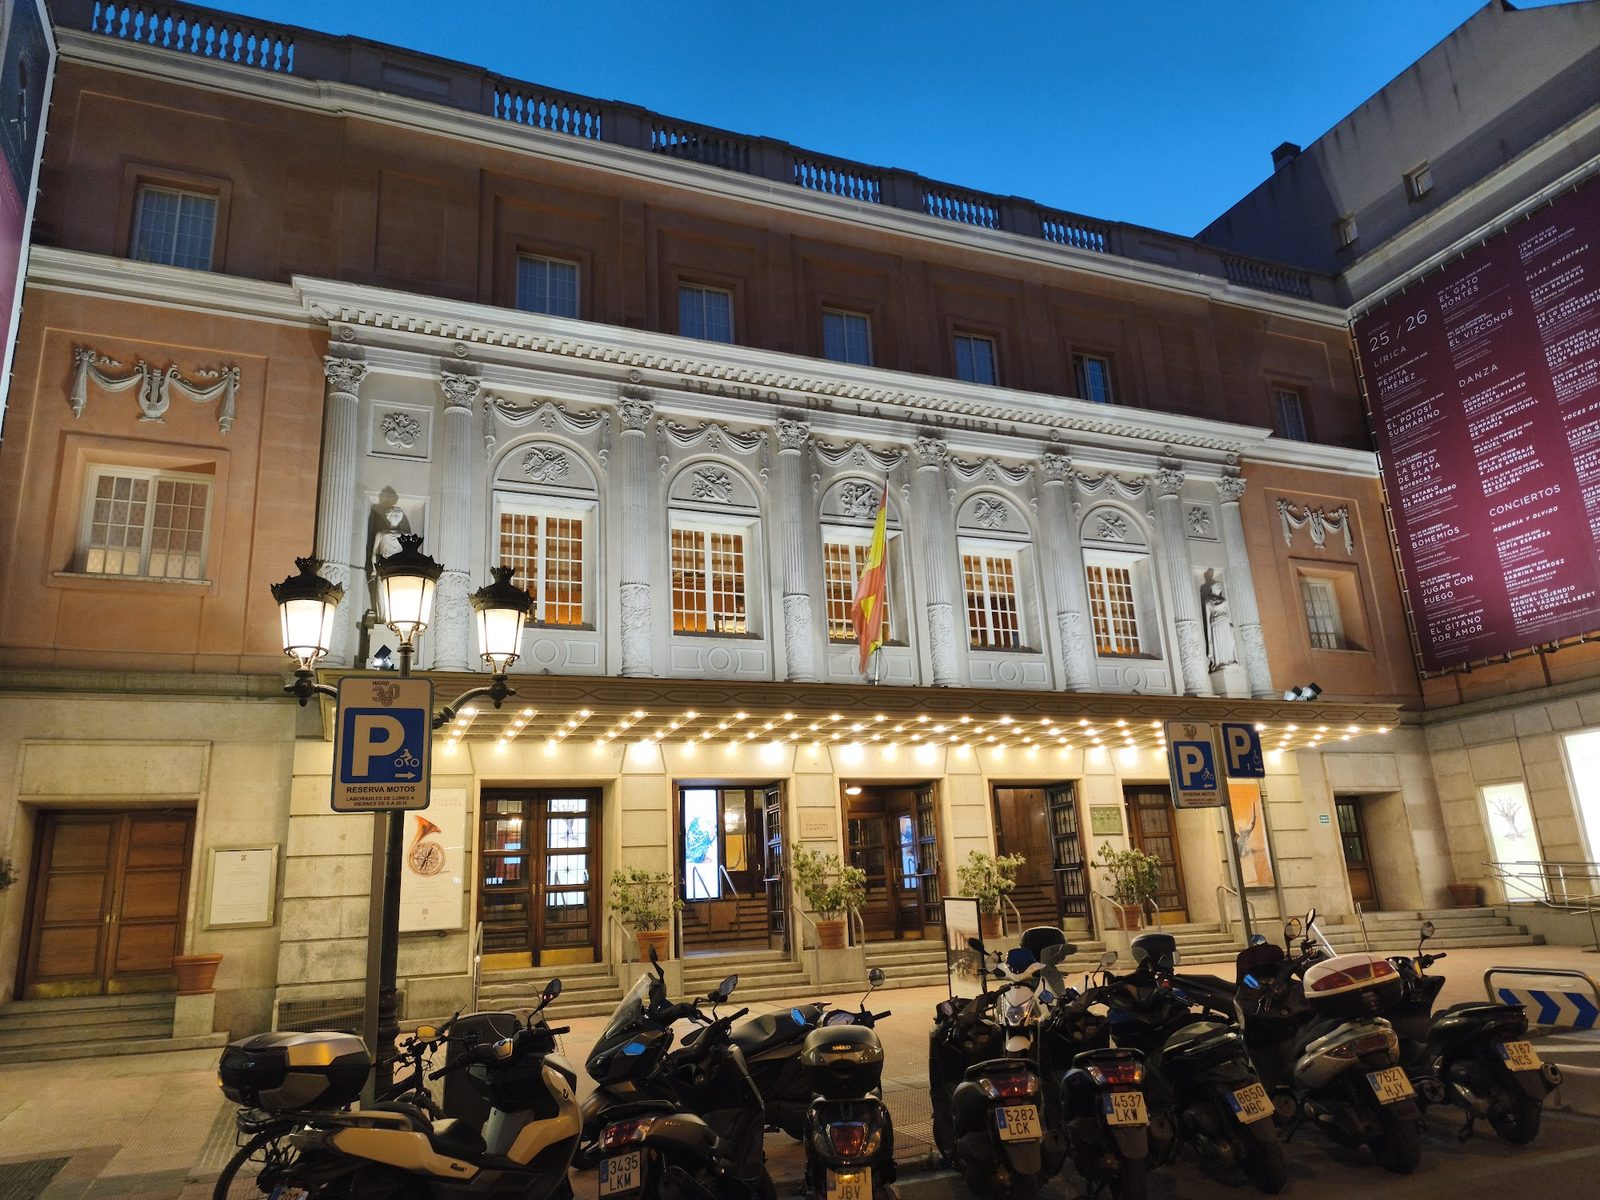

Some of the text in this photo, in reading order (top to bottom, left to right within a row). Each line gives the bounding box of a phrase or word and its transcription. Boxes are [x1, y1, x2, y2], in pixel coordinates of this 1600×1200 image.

[1552, 244, 1588, 267] NOSOTRAS
[1439, 293, 1450, 303] EL
[1453, 276, 1478, 294] GATO
[1531, 287, 1549, 299] SARA
[1551, 268, 1584, 288] BAÑERAS
[1441, 285, 1478, 310] MONTES
[1537, 316, 1546, 324] DE
[1548, 310, 1558, 318] LO
[1545, 317, 1555, 325] LO
[1369, 330, 1389, 352] 25
[1406, 309, 1427, 332] 26
[1449, 338, 1460, 347] EL
[1464, 309, 1513, 338] VIZCONDE
[1546, 346, 1562, 357] SIRA
[1547, 348, 1571, 362] OLIVIA
[1548, 355, 1567, 367] OLGA
[1378, 369, 1407, 387] PEPITA
[1380, 372, 1415, 395] JIMÉNEZ
[1459, 364, 1498, 388] DANZA
[1553, 371, 1578, 386] ELVIRA
[1465, 397, 1493, 413] ANTONIO
[1495, 382, 1526, 399] NAJARRO
[1387, 422, 1397, 430] EL
[1400, 403, 1432, 423] POTOSÍ
[1504, 399, 1539, 417] NACIONAL
[1563, 408, 1586, 421] VOCES
[1389, 409, 1440, 437] SUBMARINO
[1481, 421, 1503, 433] DANZA
[1567, 428, 1592, 441] LAURA
[1474, 441, 1500, 454] MANUEL
[1396, 467, 1408, 477] LA
[1411, 455, 1435, 470] EDAD
[1478, 461, 1496, 471] GALA
[1498, 445, 1533, 463] HOMENAJE
[1505, 450, 1535, 465] ANTONIO
[1574, 454, 1597, 467] MAITE
[1398, 462, 1441, 485] DE PLATA
[1400, 474, 1431, 491] GOYESCAS
[1483, 462, 1544, 489] BALLET NACIONAL
[1411, 485, 1439, 499] RETABLO
[1494, 477, 1520, 490] ESPAÑA
[1413, 493, 1433, 504] MAESE
[1435, 484, 1457, 495] PEDRO
[1489, 484, 1560, 516] CONCIERTOS
[1493, 519, 1523, 532] MEMORIA
[1532, 506, 1558, 519] OLVIDO
[1412, 526, 1460, 548] BOHEMIOS
[1520, 530, 1551, 545] ESPARZA
[1504, 568, 1534, 581] SABRINA
[1423, 581, 1451, 596] JUGAR
[1454, 574, 1474, 586] CON
[1540, 585, 1575, 599] LOJENDIO
[1424, 590, 1454, 604] FUEGO
[1513, 591, 1595, 618] GEMMA COMA-ALABERT
[1512, 603, 1534, 612] SILVIA
[1430, 627, 1441, 635] EL
[1445, 615, 1481, 631] GITANO
[1432, 624, 1483, 643] POR AMOR
[352, 715, 406, 777] P
[1227, 728, 1251, 769] P
[1179, 746, 1204, 786] P
[346, 786, 385, 794] RESERVA
[1506, 1044, 1530, 1056] 5167
[1376, 1069, 1403, 1084] 7621
[1237, 1086, 1265, 1105] 8650
[1384, 1082, 1405, 1097] HJY
[1114, 1095, 1141, 1108] 4537
[1243, 1100, 1265, 1117] MBC
[1005, 1108, 1035, 1122] 5282
[1115, 1108, 1138, 1122] LKW
[1008, 1122, 1031, 1136] LCK
[610, 1155, 638, 1175] 3435
[610, 1172, 631, 1191] LKM
[838, 1185, 860, 1200] JBV
